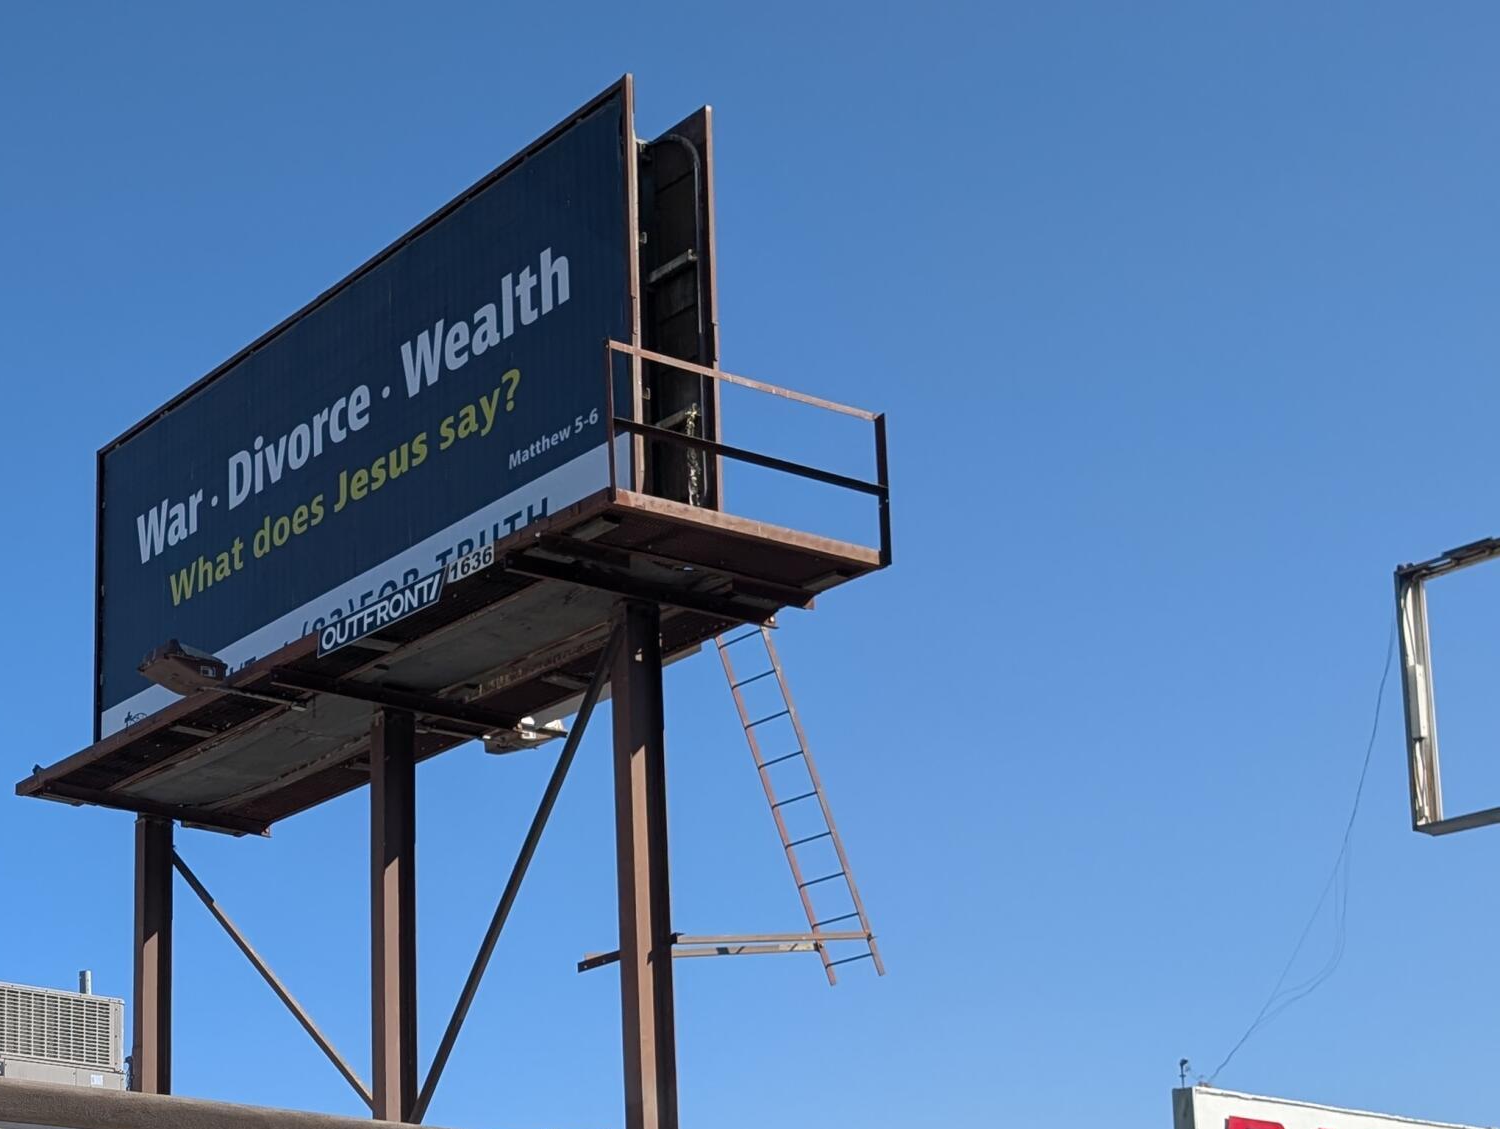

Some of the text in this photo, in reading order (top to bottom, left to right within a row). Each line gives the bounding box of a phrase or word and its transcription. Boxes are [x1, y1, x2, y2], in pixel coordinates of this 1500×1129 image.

[137, 489, 203, 564] War
[229, 384, 371, 511] Divorce
[401, 247, 570, 398] Wealth
[509, 408, 598, 470] Matthew 5-6
[170, 537, 244, 606] What
[253, 494, 324, 558] does
[334, 432, 427, 513] Jesus
[440, 369, 521, 450] say?
[450, 545, 493, 579] 1636
